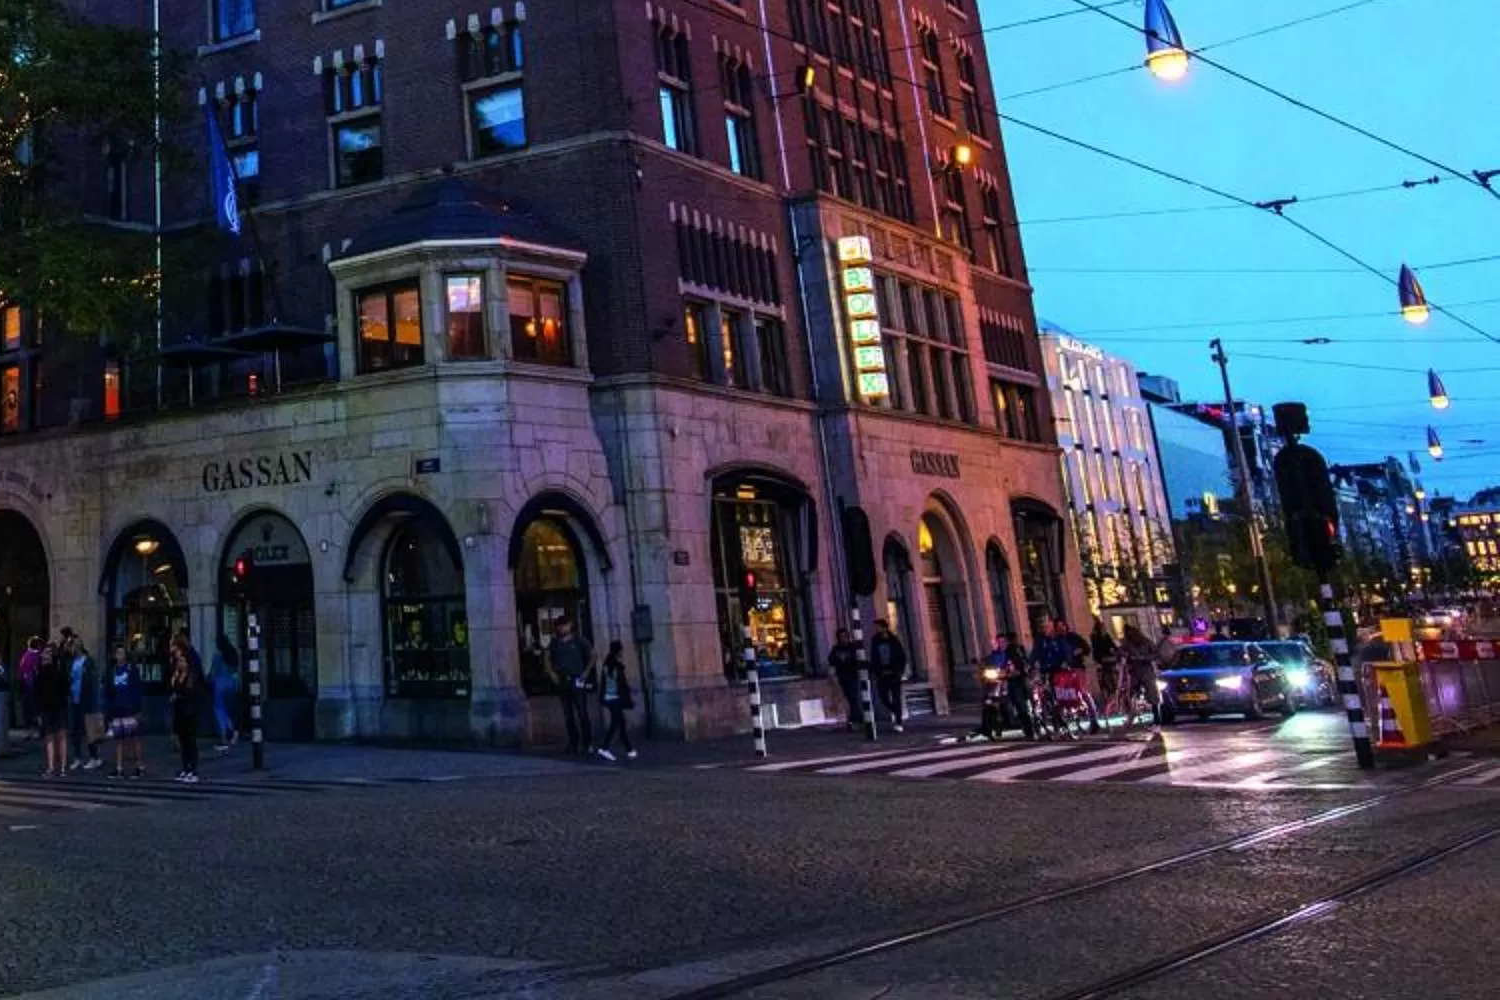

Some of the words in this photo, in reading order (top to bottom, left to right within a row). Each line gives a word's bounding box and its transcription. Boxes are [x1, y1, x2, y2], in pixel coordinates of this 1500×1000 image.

[845, 268, 881, 394] ROLEX
[202, 451, 312, 493] GASSAN
[251, 544, 289, 561] OLEX
